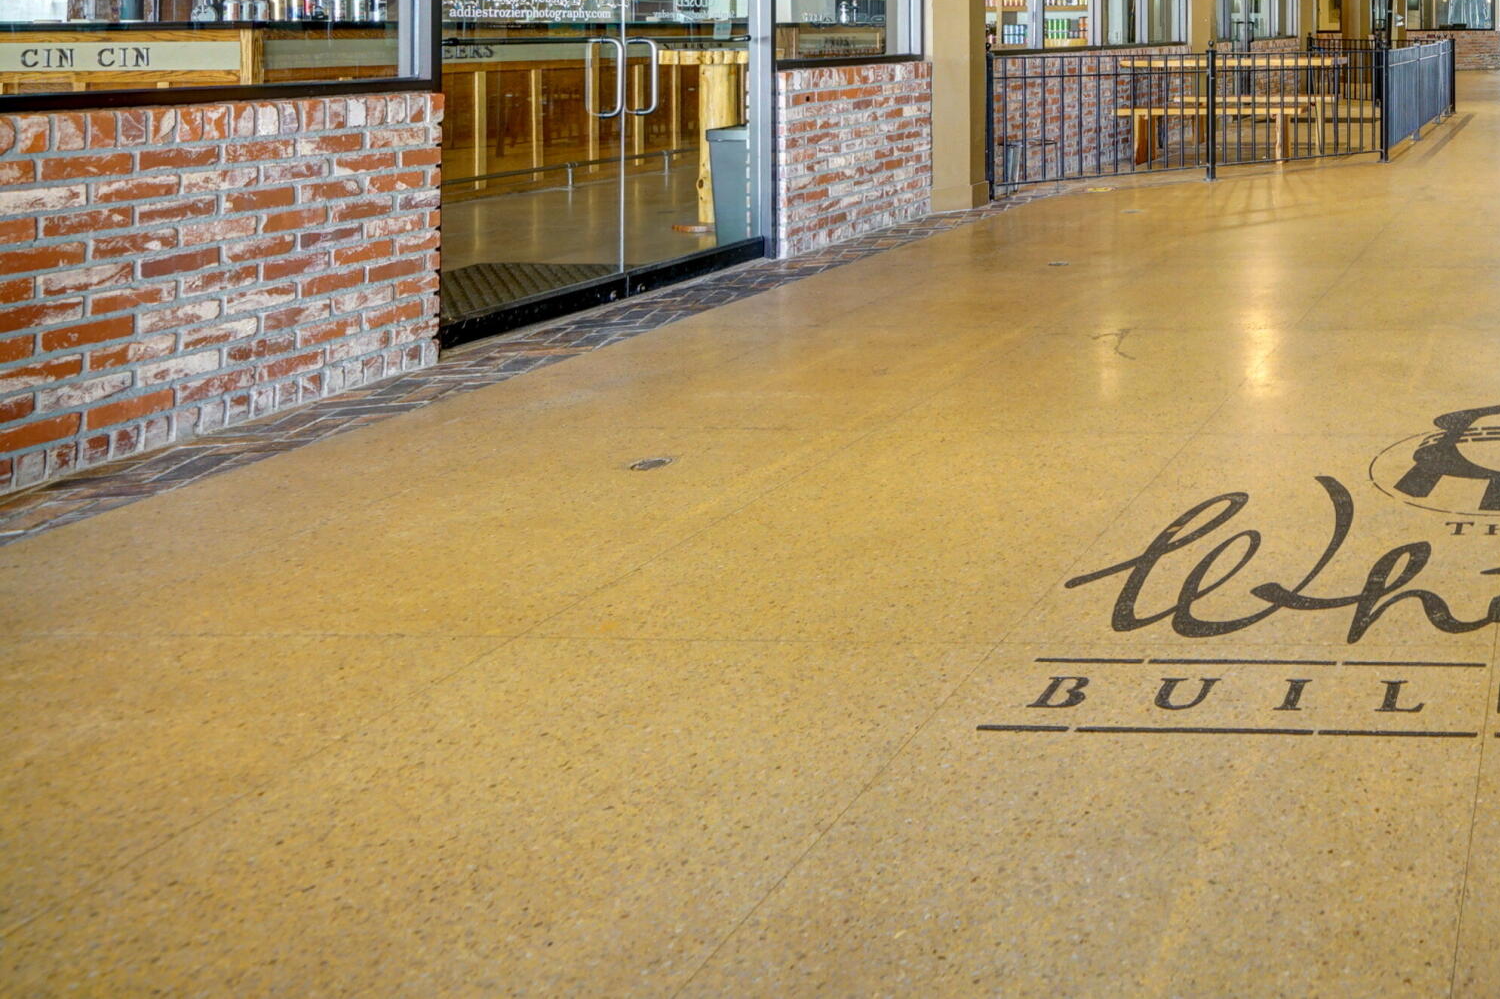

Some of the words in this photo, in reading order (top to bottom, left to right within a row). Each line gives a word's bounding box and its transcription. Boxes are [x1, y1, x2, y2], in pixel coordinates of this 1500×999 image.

[449, 5, 612, 22] addiestrozierphotography.com
[20, 48, 74, 68] CIN
[97, 46, 151, 68] CIN
